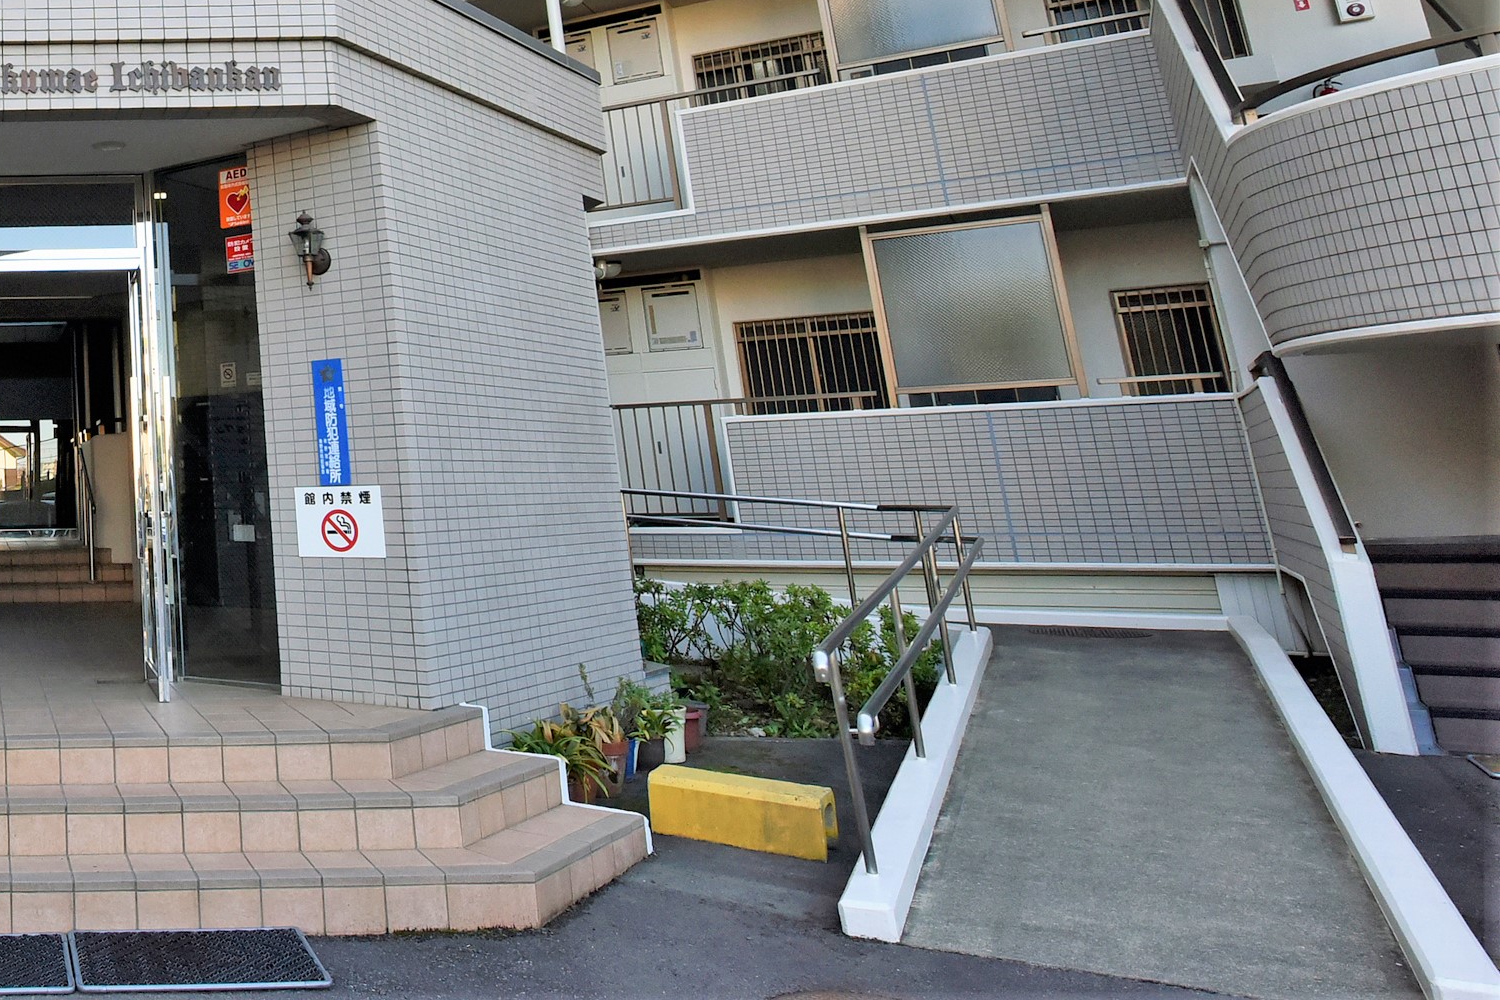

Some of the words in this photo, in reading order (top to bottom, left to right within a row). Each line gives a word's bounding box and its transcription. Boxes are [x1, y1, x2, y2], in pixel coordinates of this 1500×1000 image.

[109, 60, 281, 95] Ichibankan
[226, 168, 247, 180] AED
[323, 386, 341, 483] 地域防犯連絡所
[304, 491, 371, 505] 館内禁煙
